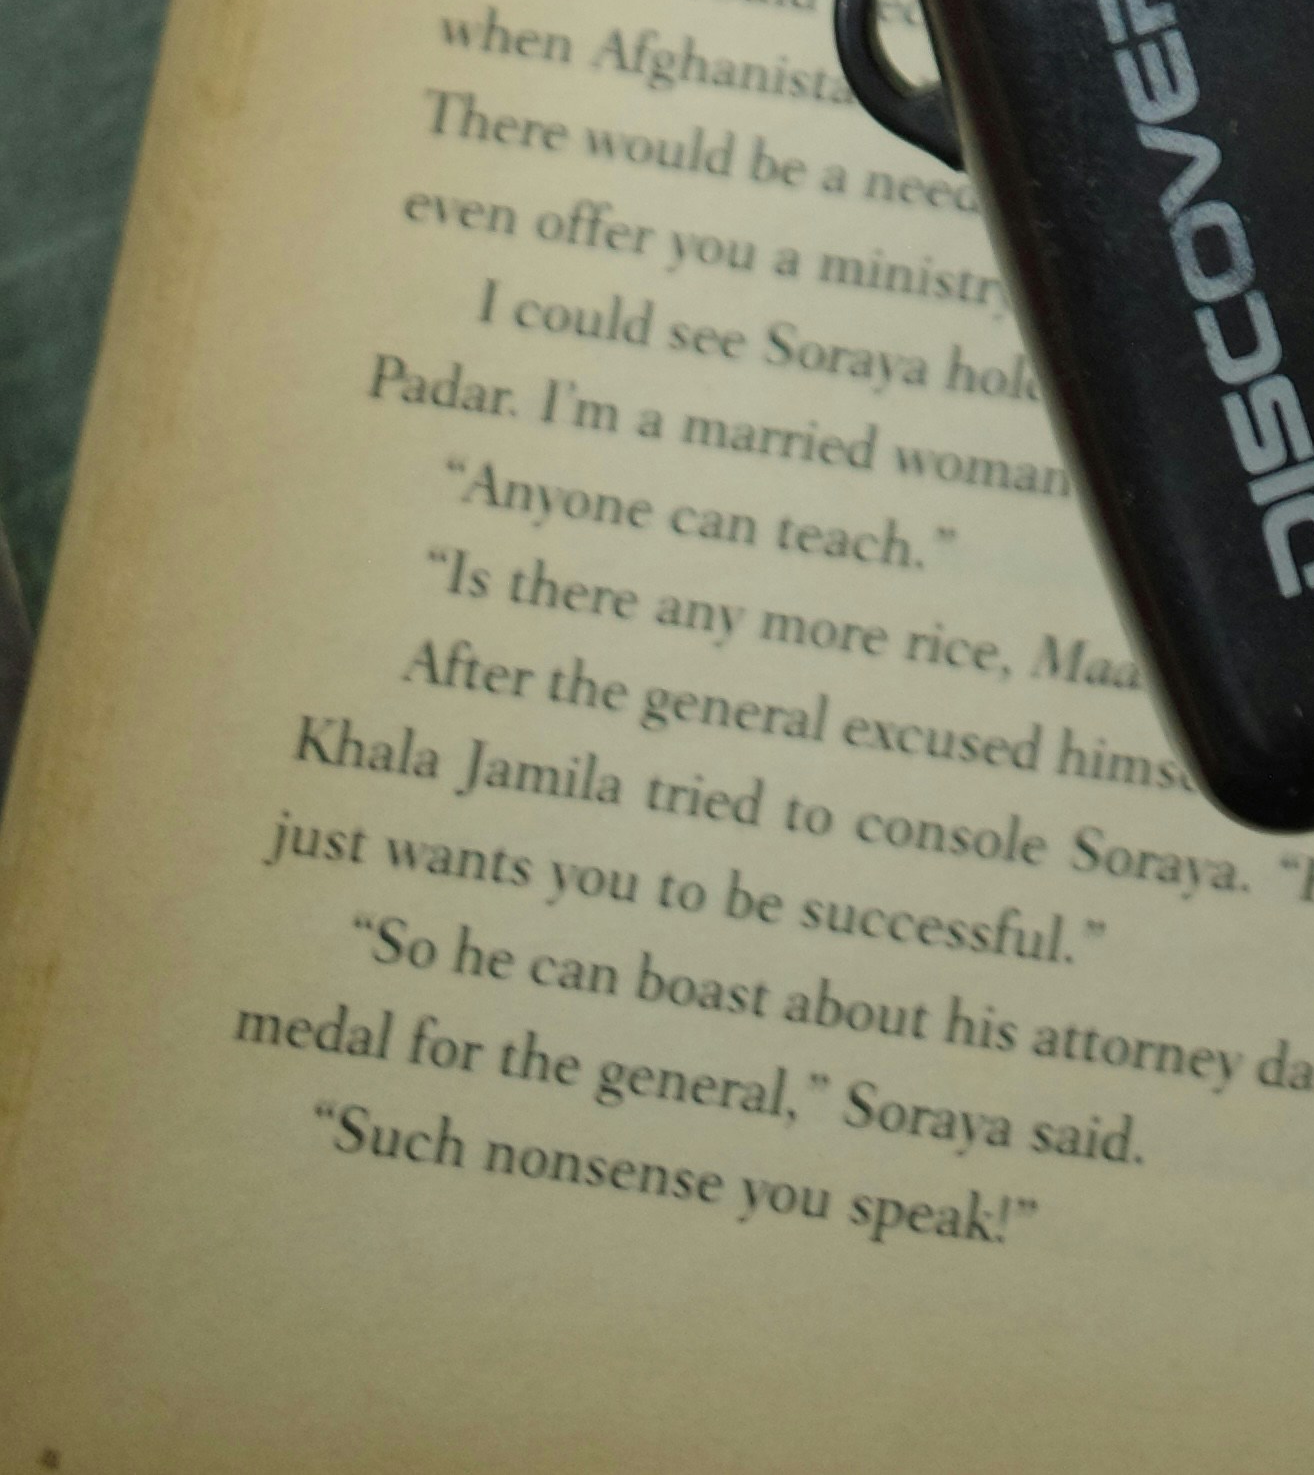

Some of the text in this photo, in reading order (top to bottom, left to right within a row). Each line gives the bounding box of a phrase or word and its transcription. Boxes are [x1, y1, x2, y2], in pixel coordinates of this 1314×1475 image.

[440, 5, 845, 96] when Afghanista
[425, 88, 569, 152] There
[585, 126, 735, 178] would
[748, 135, 807, 188] be
[819, 165, 847, 195] a
[402, 193, 516, 236] even
[534, 199, 654, 255] offer
[667, 231, 756, 272] you
[772, 248, 800, 278] a
[478, 278, 498, 324] I
[512, 294, 654, 347] could
[668, 324, 745, 359] see
[765, 326, 927, 393] Soraya
[368, 353, 1074, 498] Padar. I'm a married woman
[668, 506, 757, 546] can
[509, 558, 638, 619] there
[654, 597, 744, 647] any
[760, 611, 888, 657] more
[905, 623, 1010, 677] rice,
[402, 639, 1196, 794] After the general excused hims
[294, 715, 439, 779] Khala
[453, 738, 621, 804] Jamila
[645, 774, 765, 827] tried
[784, 797, 833, 836] to
[854, 813, 1046, 865] console
[1072, 828, 1249, 900] Soraya.
[263, 810, 366, 866] just
[386, 838, 531, 886] wants
[547, 861, 638, 905] you
[657, 874, 706, 911] to
[724, 868, 783, 924] be
[453, 924, 514, 980] he
[528, 956, 618, 995] can
[635, 951, 768, 1018] boast
[782, 977, 927, 1040] about
[944, 995, 1015, 1051] his
[1031, 1026, 1234, 1094] attorney
[234, 1003, 394, 1059] medal
[407, 1015, 484, 1072] for
[499, 1029, 580, 1085] the
[844, 1082, 1011, 1156] Soraya
[1030, 1113, 1142, 1164] said.
[484, 1141, 723, 1203] nonsense
[739, 1178, 829, 1222] you
